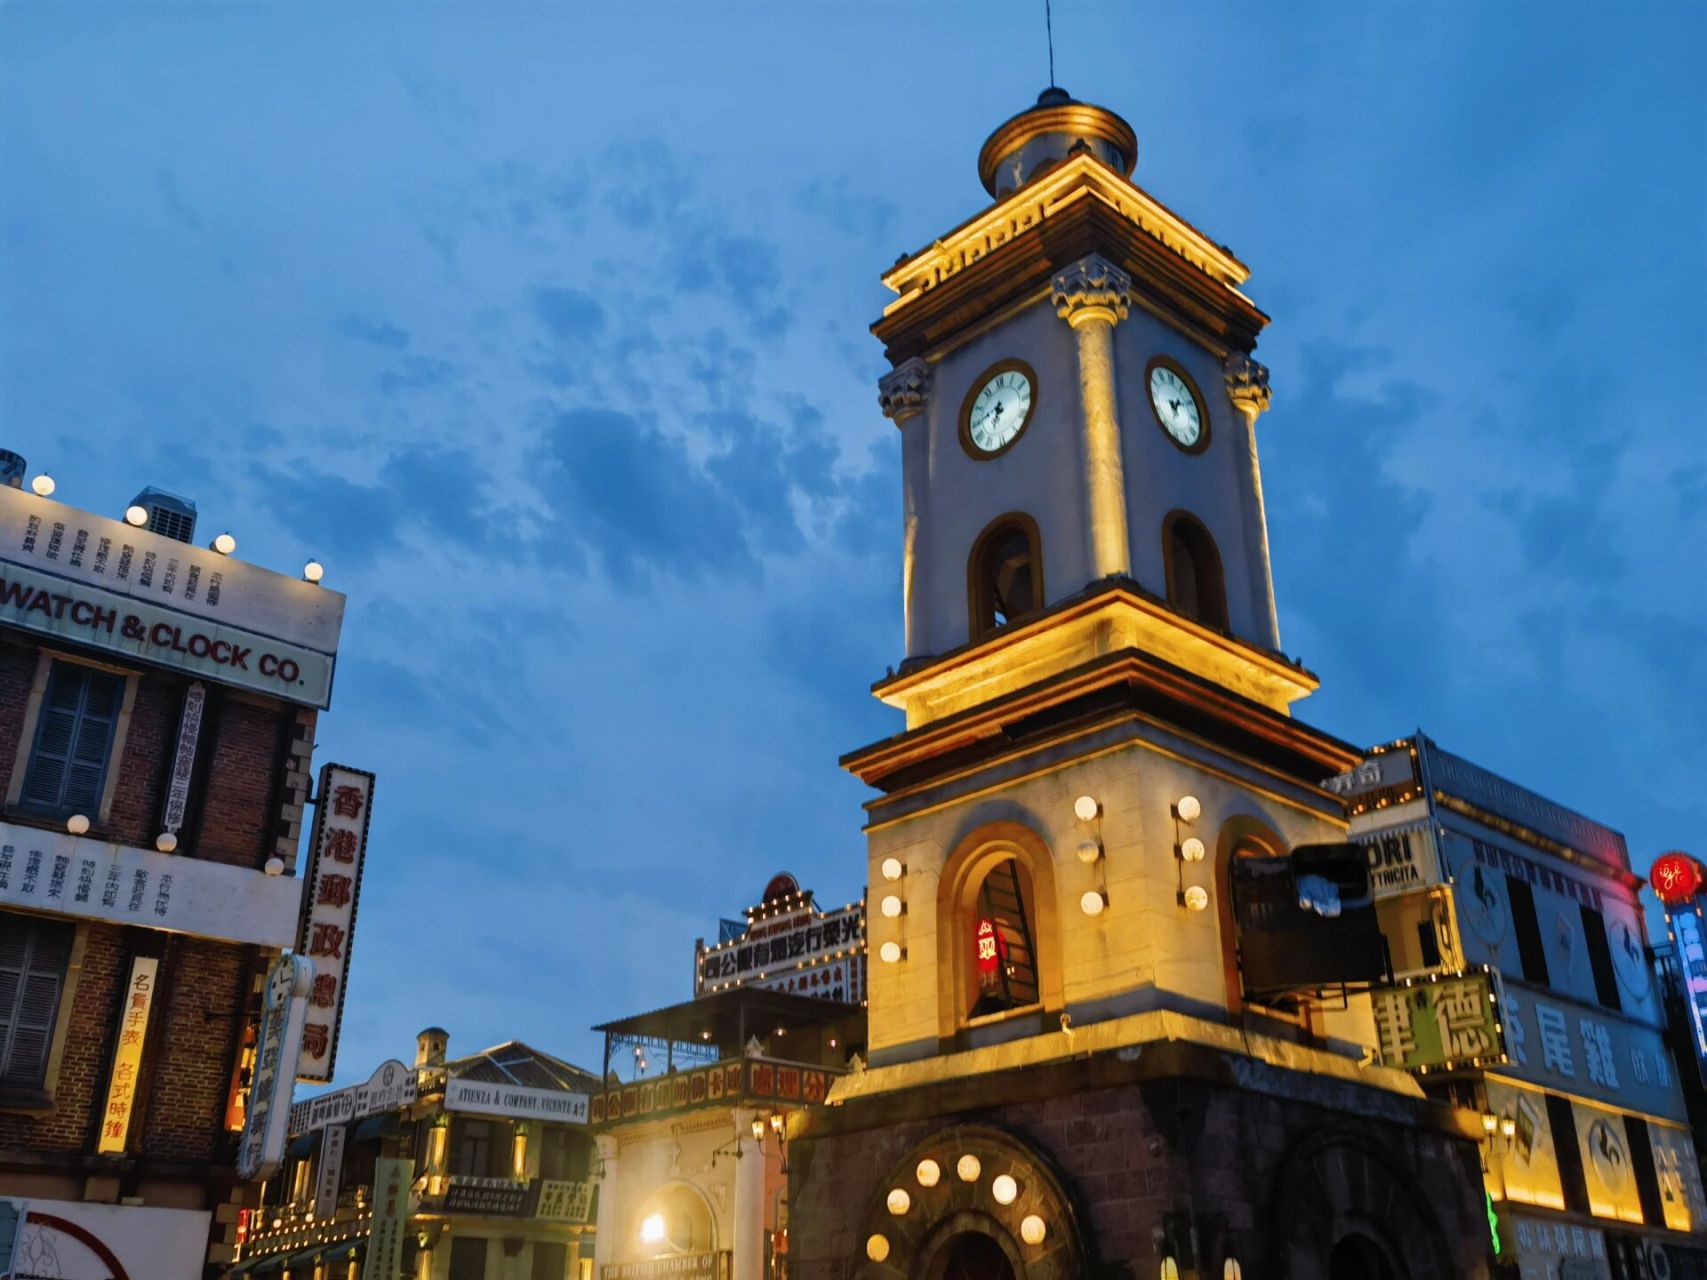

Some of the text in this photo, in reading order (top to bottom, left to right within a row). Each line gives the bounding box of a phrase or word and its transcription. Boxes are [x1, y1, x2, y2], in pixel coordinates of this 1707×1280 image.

[0, 578, 305, 686] WATCH & CLOCK CO.
